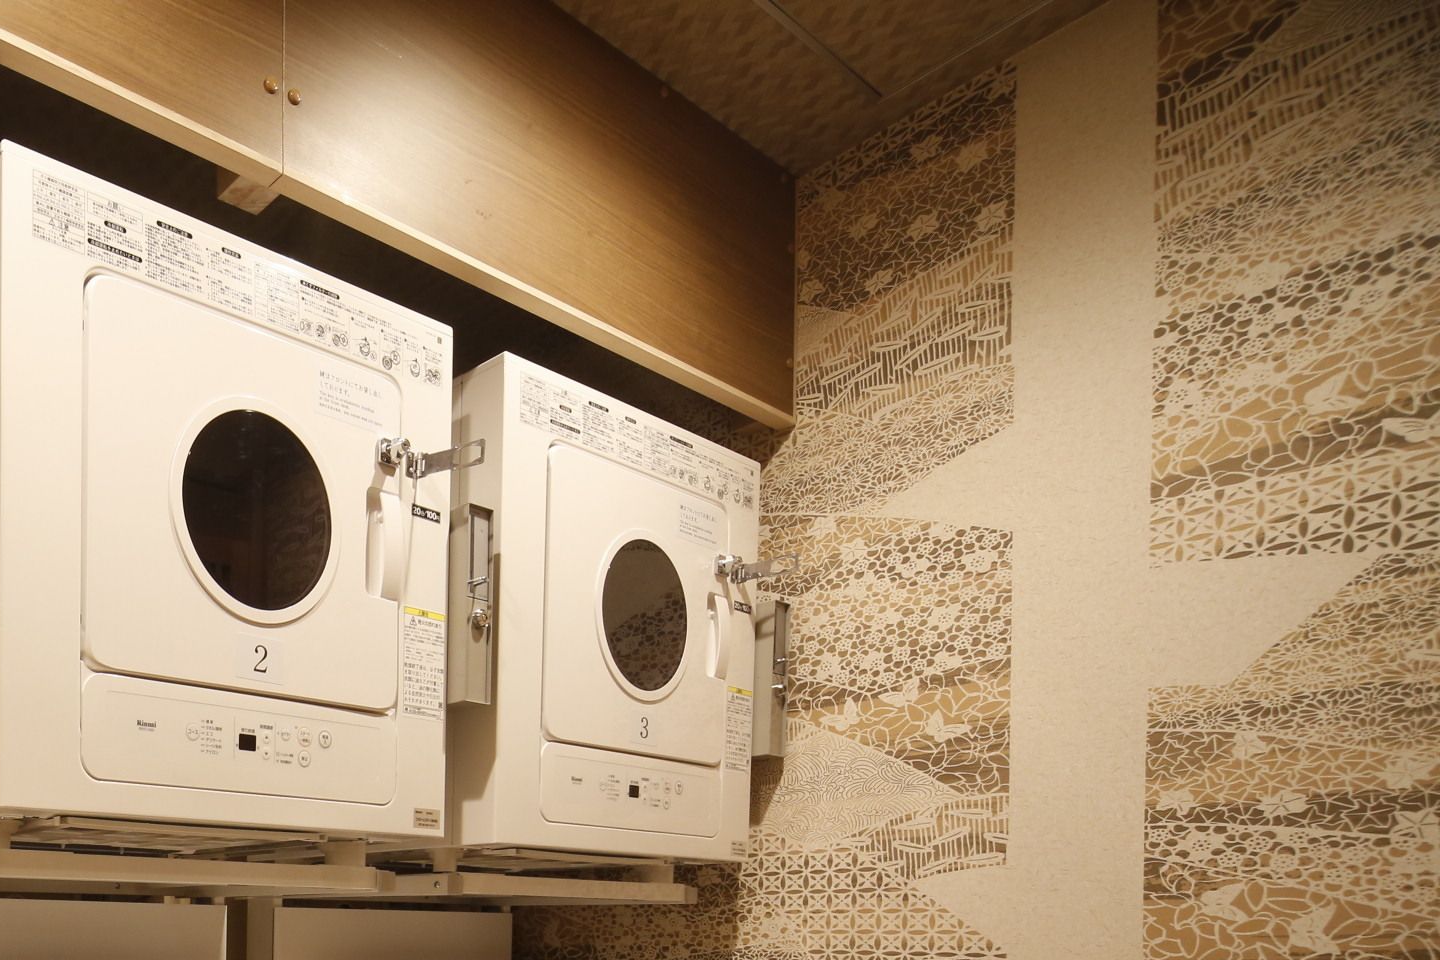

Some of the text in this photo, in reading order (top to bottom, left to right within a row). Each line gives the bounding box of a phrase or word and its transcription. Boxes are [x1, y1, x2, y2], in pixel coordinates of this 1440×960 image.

[253, 644, 268, 673] 2
[136, 719, 157, 729] Rinnai
[640, 716, 649, 739] 3
